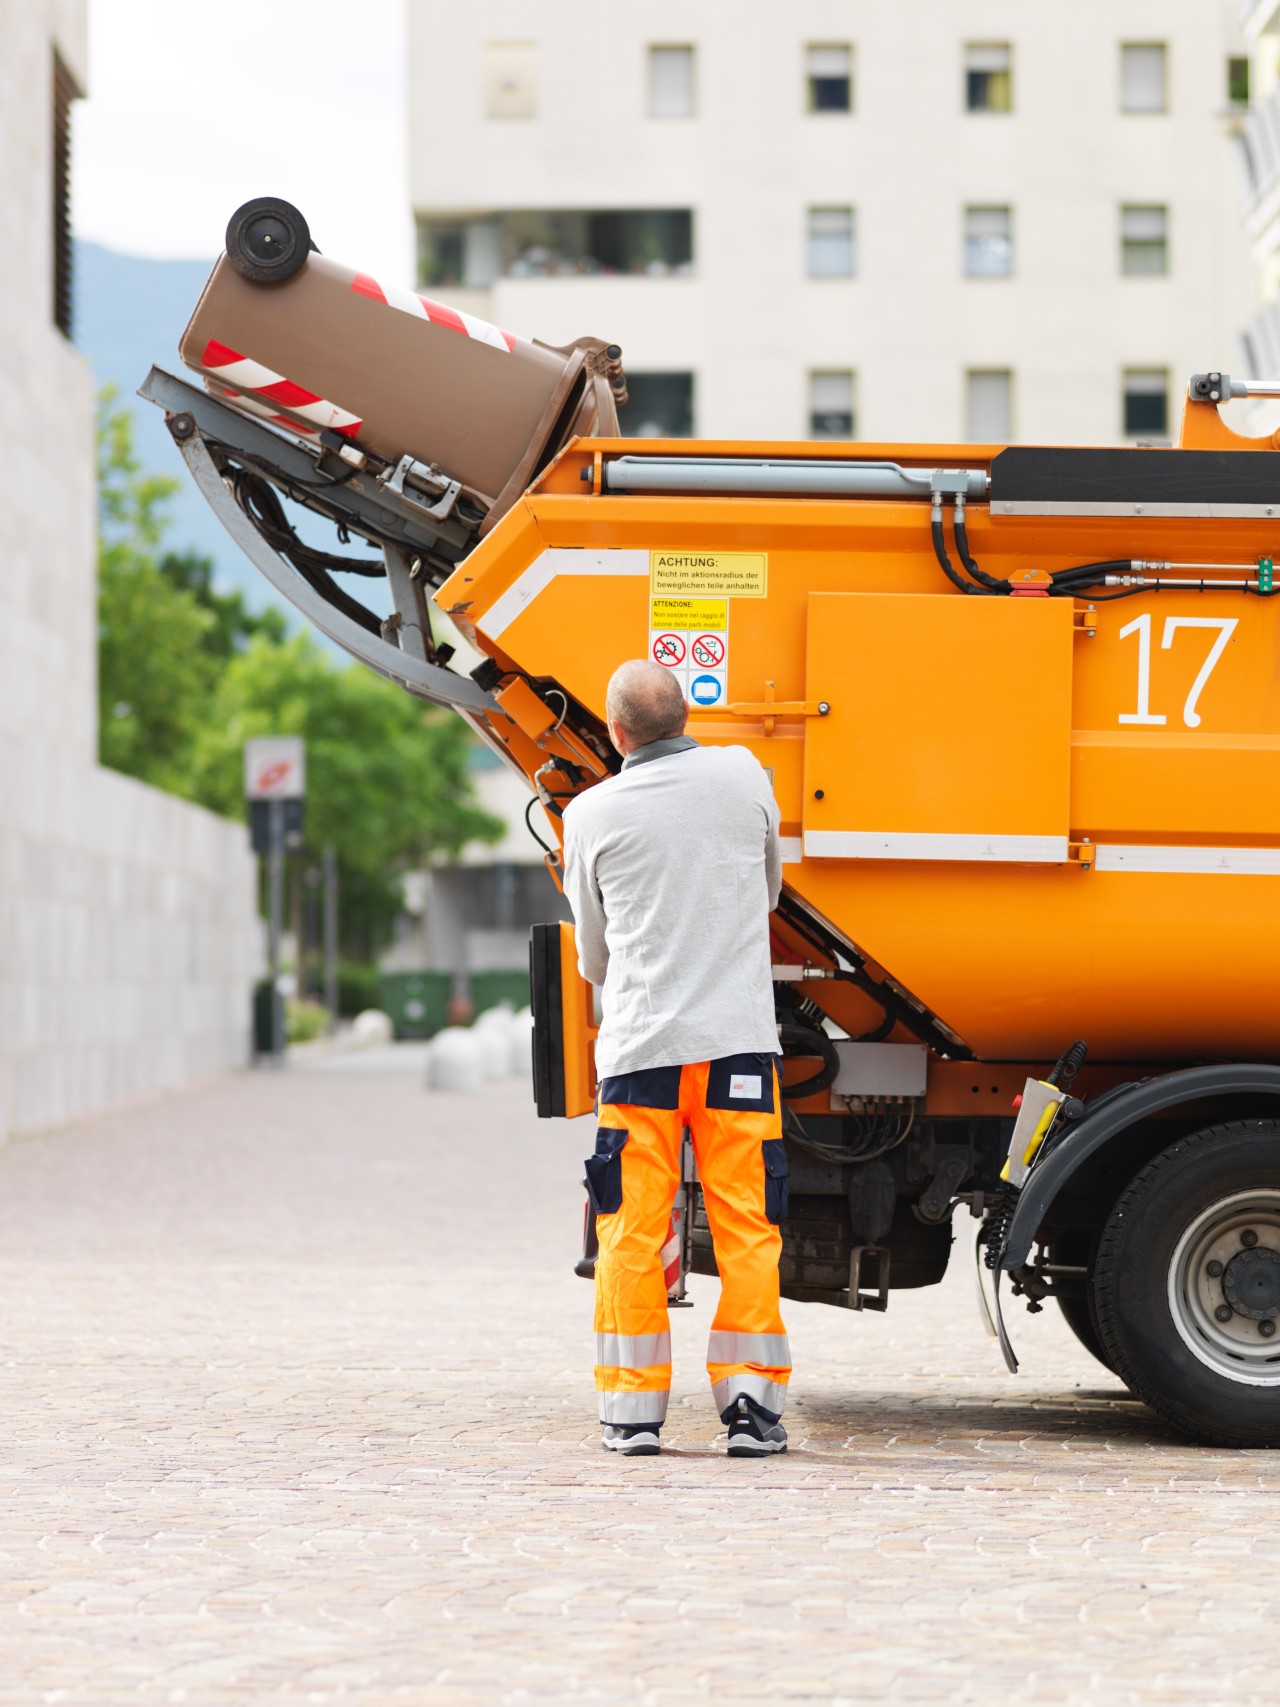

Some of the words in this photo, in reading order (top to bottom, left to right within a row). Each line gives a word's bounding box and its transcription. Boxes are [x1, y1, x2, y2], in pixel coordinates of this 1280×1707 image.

[658, 557, 718, 567] ACHTUNG:
[690, 571, 744, 579] aktionsradius
[657, 582, 705, 590] beweglichen
[653, 600, 693, 608] ATTENZIONE:
[688, 621, 702, 629] parti
[1118, 613, 1239, 728] 17
